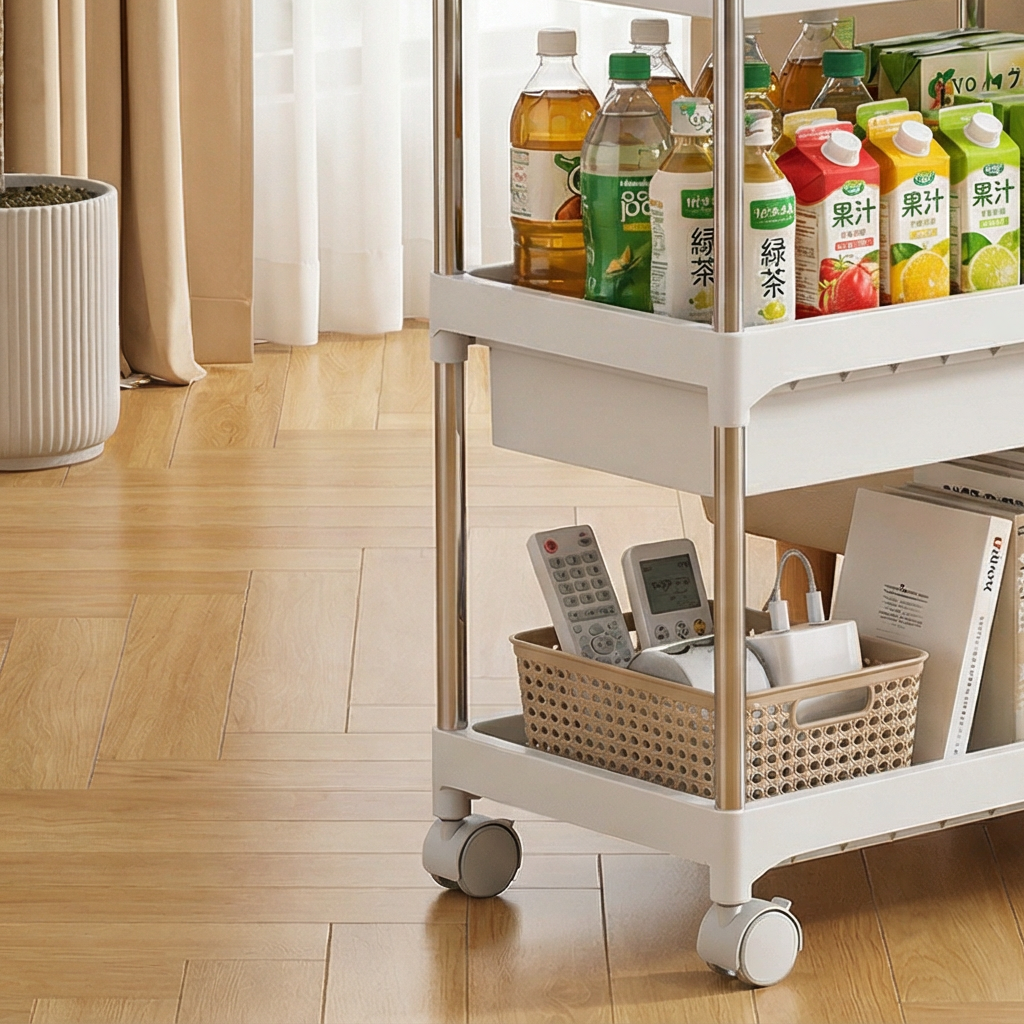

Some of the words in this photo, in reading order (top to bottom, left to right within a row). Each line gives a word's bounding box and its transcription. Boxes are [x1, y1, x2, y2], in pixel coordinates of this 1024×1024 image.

[901, 188, 944, 218] 果汁
[972, 179, 1015, 207] 果汁
[832, 198, 877, 228] 果汁
